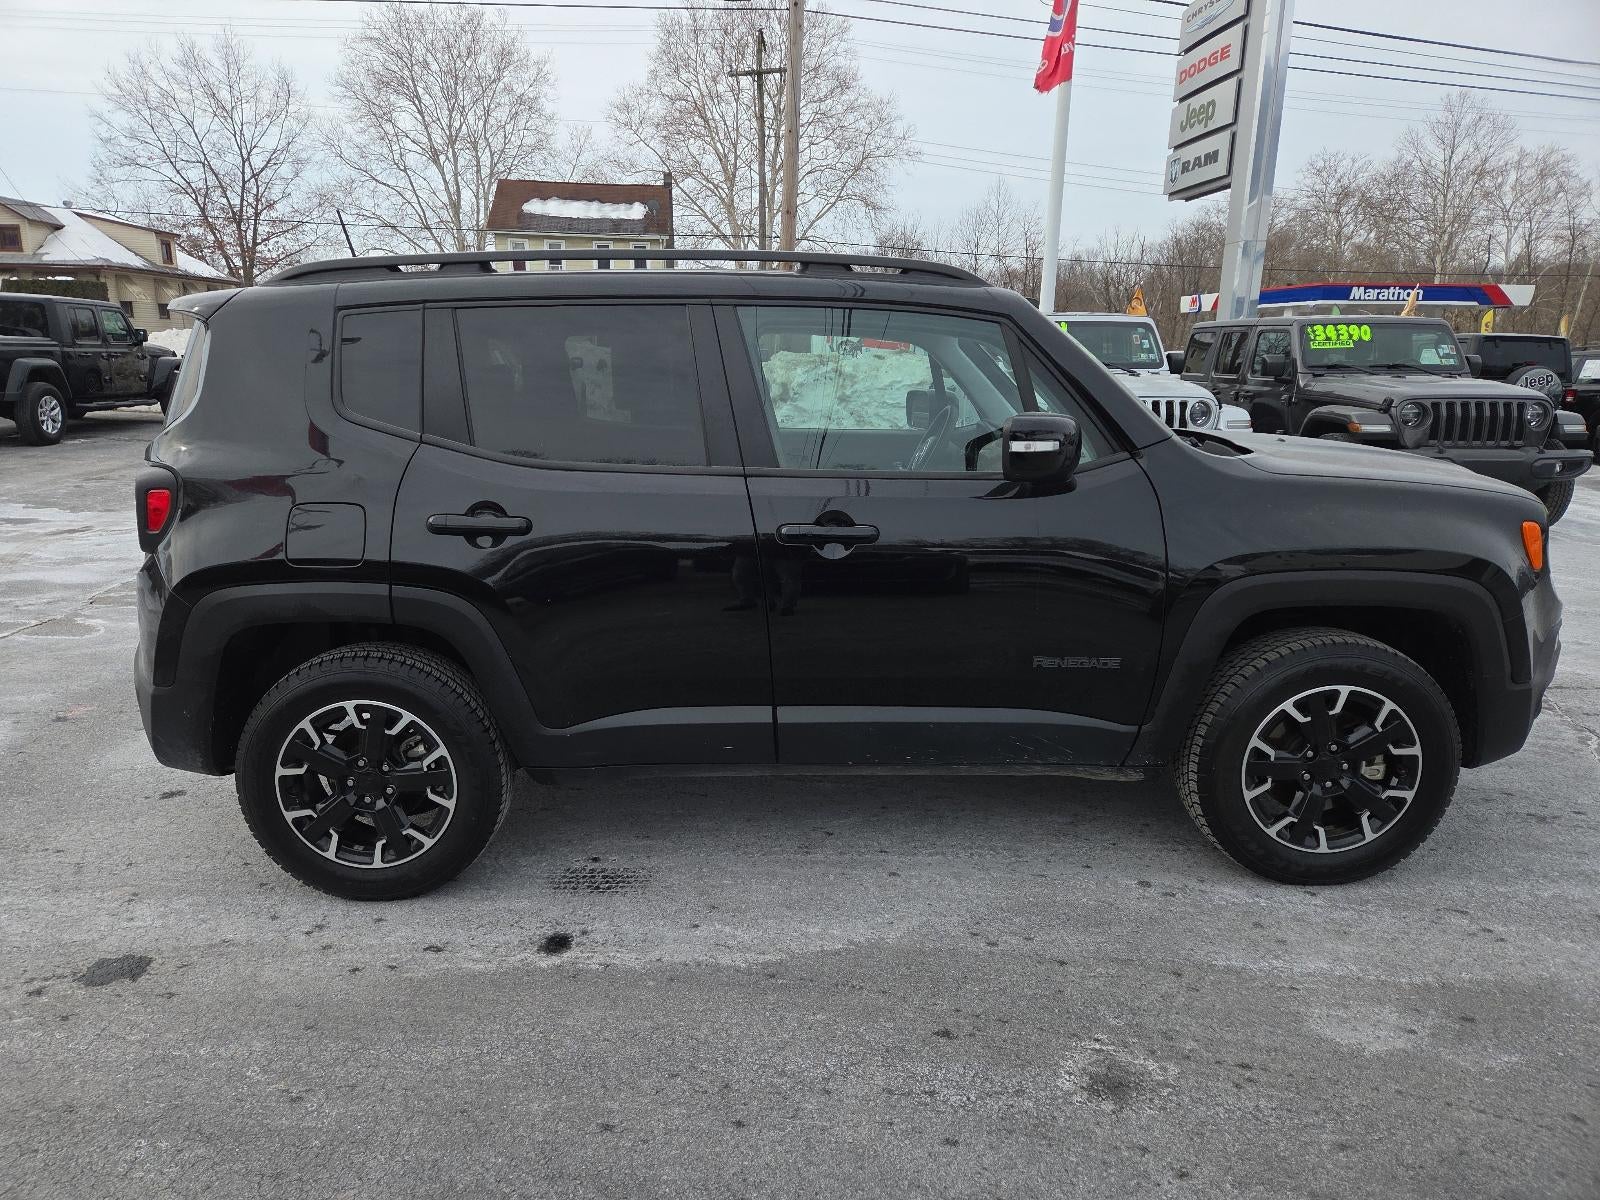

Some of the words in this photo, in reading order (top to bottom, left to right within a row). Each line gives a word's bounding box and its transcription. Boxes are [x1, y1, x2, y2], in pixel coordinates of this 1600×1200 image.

[1186, 0, 1221, 23] CHRYS
[1179, 43, 1232, 85] DODGE
[1180, 99, 1217, 132] Jeep
[1180, 149, 1220, 175] RAM
[1350, 286, 1423, 300] Marathon
[1520, 374, 1554, 388] Jeep
[1032, 656, 1122, 669] RENEGADE
